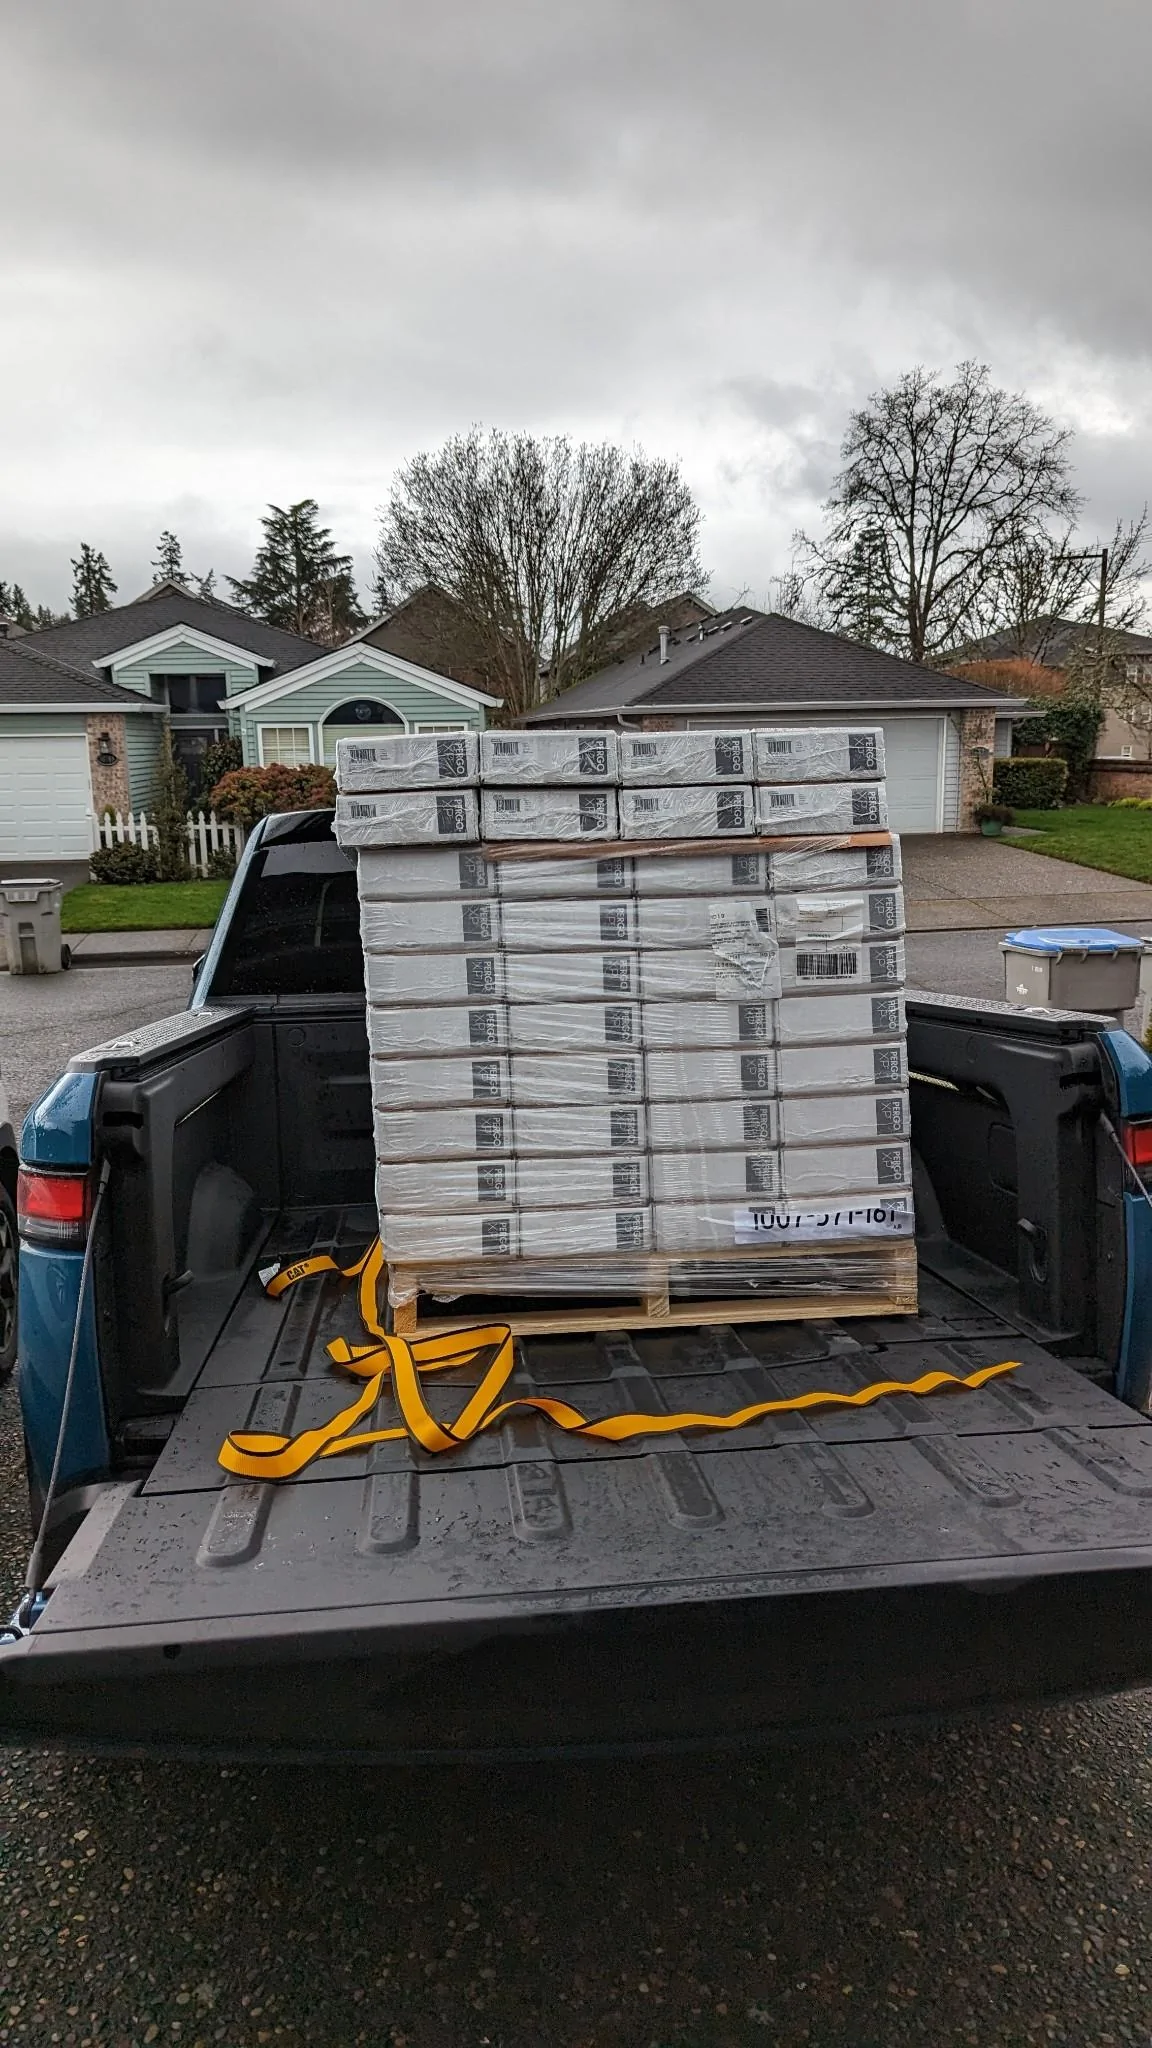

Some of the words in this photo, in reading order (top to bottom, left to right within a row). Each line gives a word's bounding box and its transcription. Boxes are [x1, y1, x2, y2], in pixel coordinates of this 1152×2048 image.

[454, 742, 464, 775] PERGO
[595, 740, 606, 772] PERGO
[731, 740, 742, 772] PERGO
[865, 736, 874, 767] PERGO
[442, 799, 454, 817] XP
[733, 794, 743, 825] PERGO
[867, 791, 877, 821] PERGO
[465, 855, 476, 873] XP
[882, 848, 892, 874] ERGO
[468, 906, 480, 925] XP
[875, 897, 886, 915] XP
[885, 896, 894, 926] PERGO
[616, 907, 626, 938] PERGO
[875, 950, 886, 967] XP
[886, 948, 895, 979] PERGO
[483, 961, 493, 993] PERGO
[474, 1014, 487, 1031] XP
[878, 1001, 888, 1018] XP
[887, 999, 896, 1030] PERGO
[486, 1013, 496, 1044] PERGO
[747, 1059, 758, 1076] XP
[757, 1057, 766, 1088] PERGO
[879, 1051, 890, 1069] XP
[890, 1051, 900, 1081] PERGO
[759, 1108, 768, 1138] PERGO
[881, 1102, 892, 1119] XP
[892, 1101, 902, 1132] PERGO
[493, 1117, 501, 1147] PERGO
[882, 1152, 893, 1168] XP
[892, 1151, 902, 1180] PERGO
[484, 1168, 495, 1187] XP
